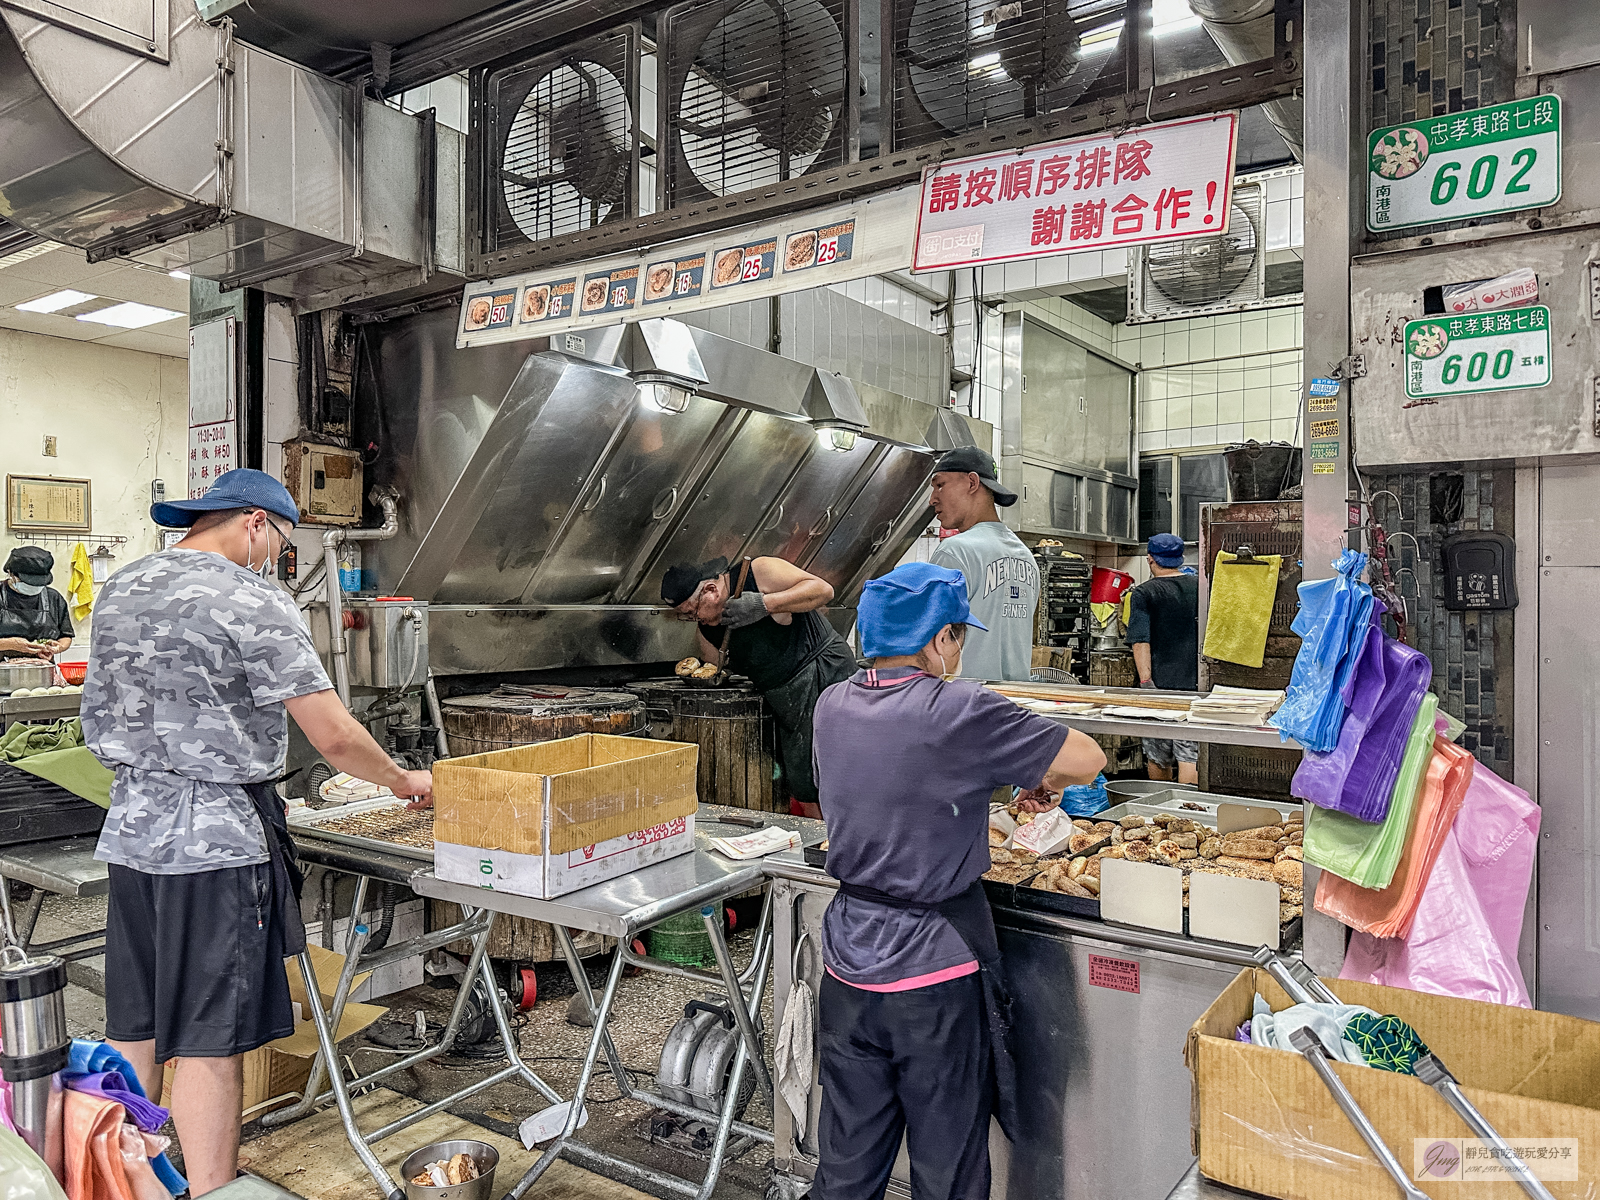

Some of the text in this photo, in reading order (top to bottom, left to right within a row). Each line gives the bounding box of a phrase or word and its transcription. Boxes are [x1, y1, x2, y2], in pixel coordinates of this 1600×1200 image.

[1430, 101, 1553, 146] 忠孝東路七段
[929, 140, 1154, 214] 請按順序排隊
[1430, 147, 1538, 206] 602
[1375, 184, 1392, 224] 南港區
[818, 240, 837, 263] 25
[743, 258, 761, 280] 25
[680, 274, 689, 293] 15
[551, 298, 561, 315] 15
[615, 287, 625, 305] 15
[492, 306, 506, 322] 50
[1449, 310, 1545, 337] 忠孝東路七段
[1441, 349, 1514, 385] 600
[1521, 355, 1544, 367] 五樓
[1411, 360, 1423, 393] 南港區
[1002, 603, 1027, 618] GNTS
